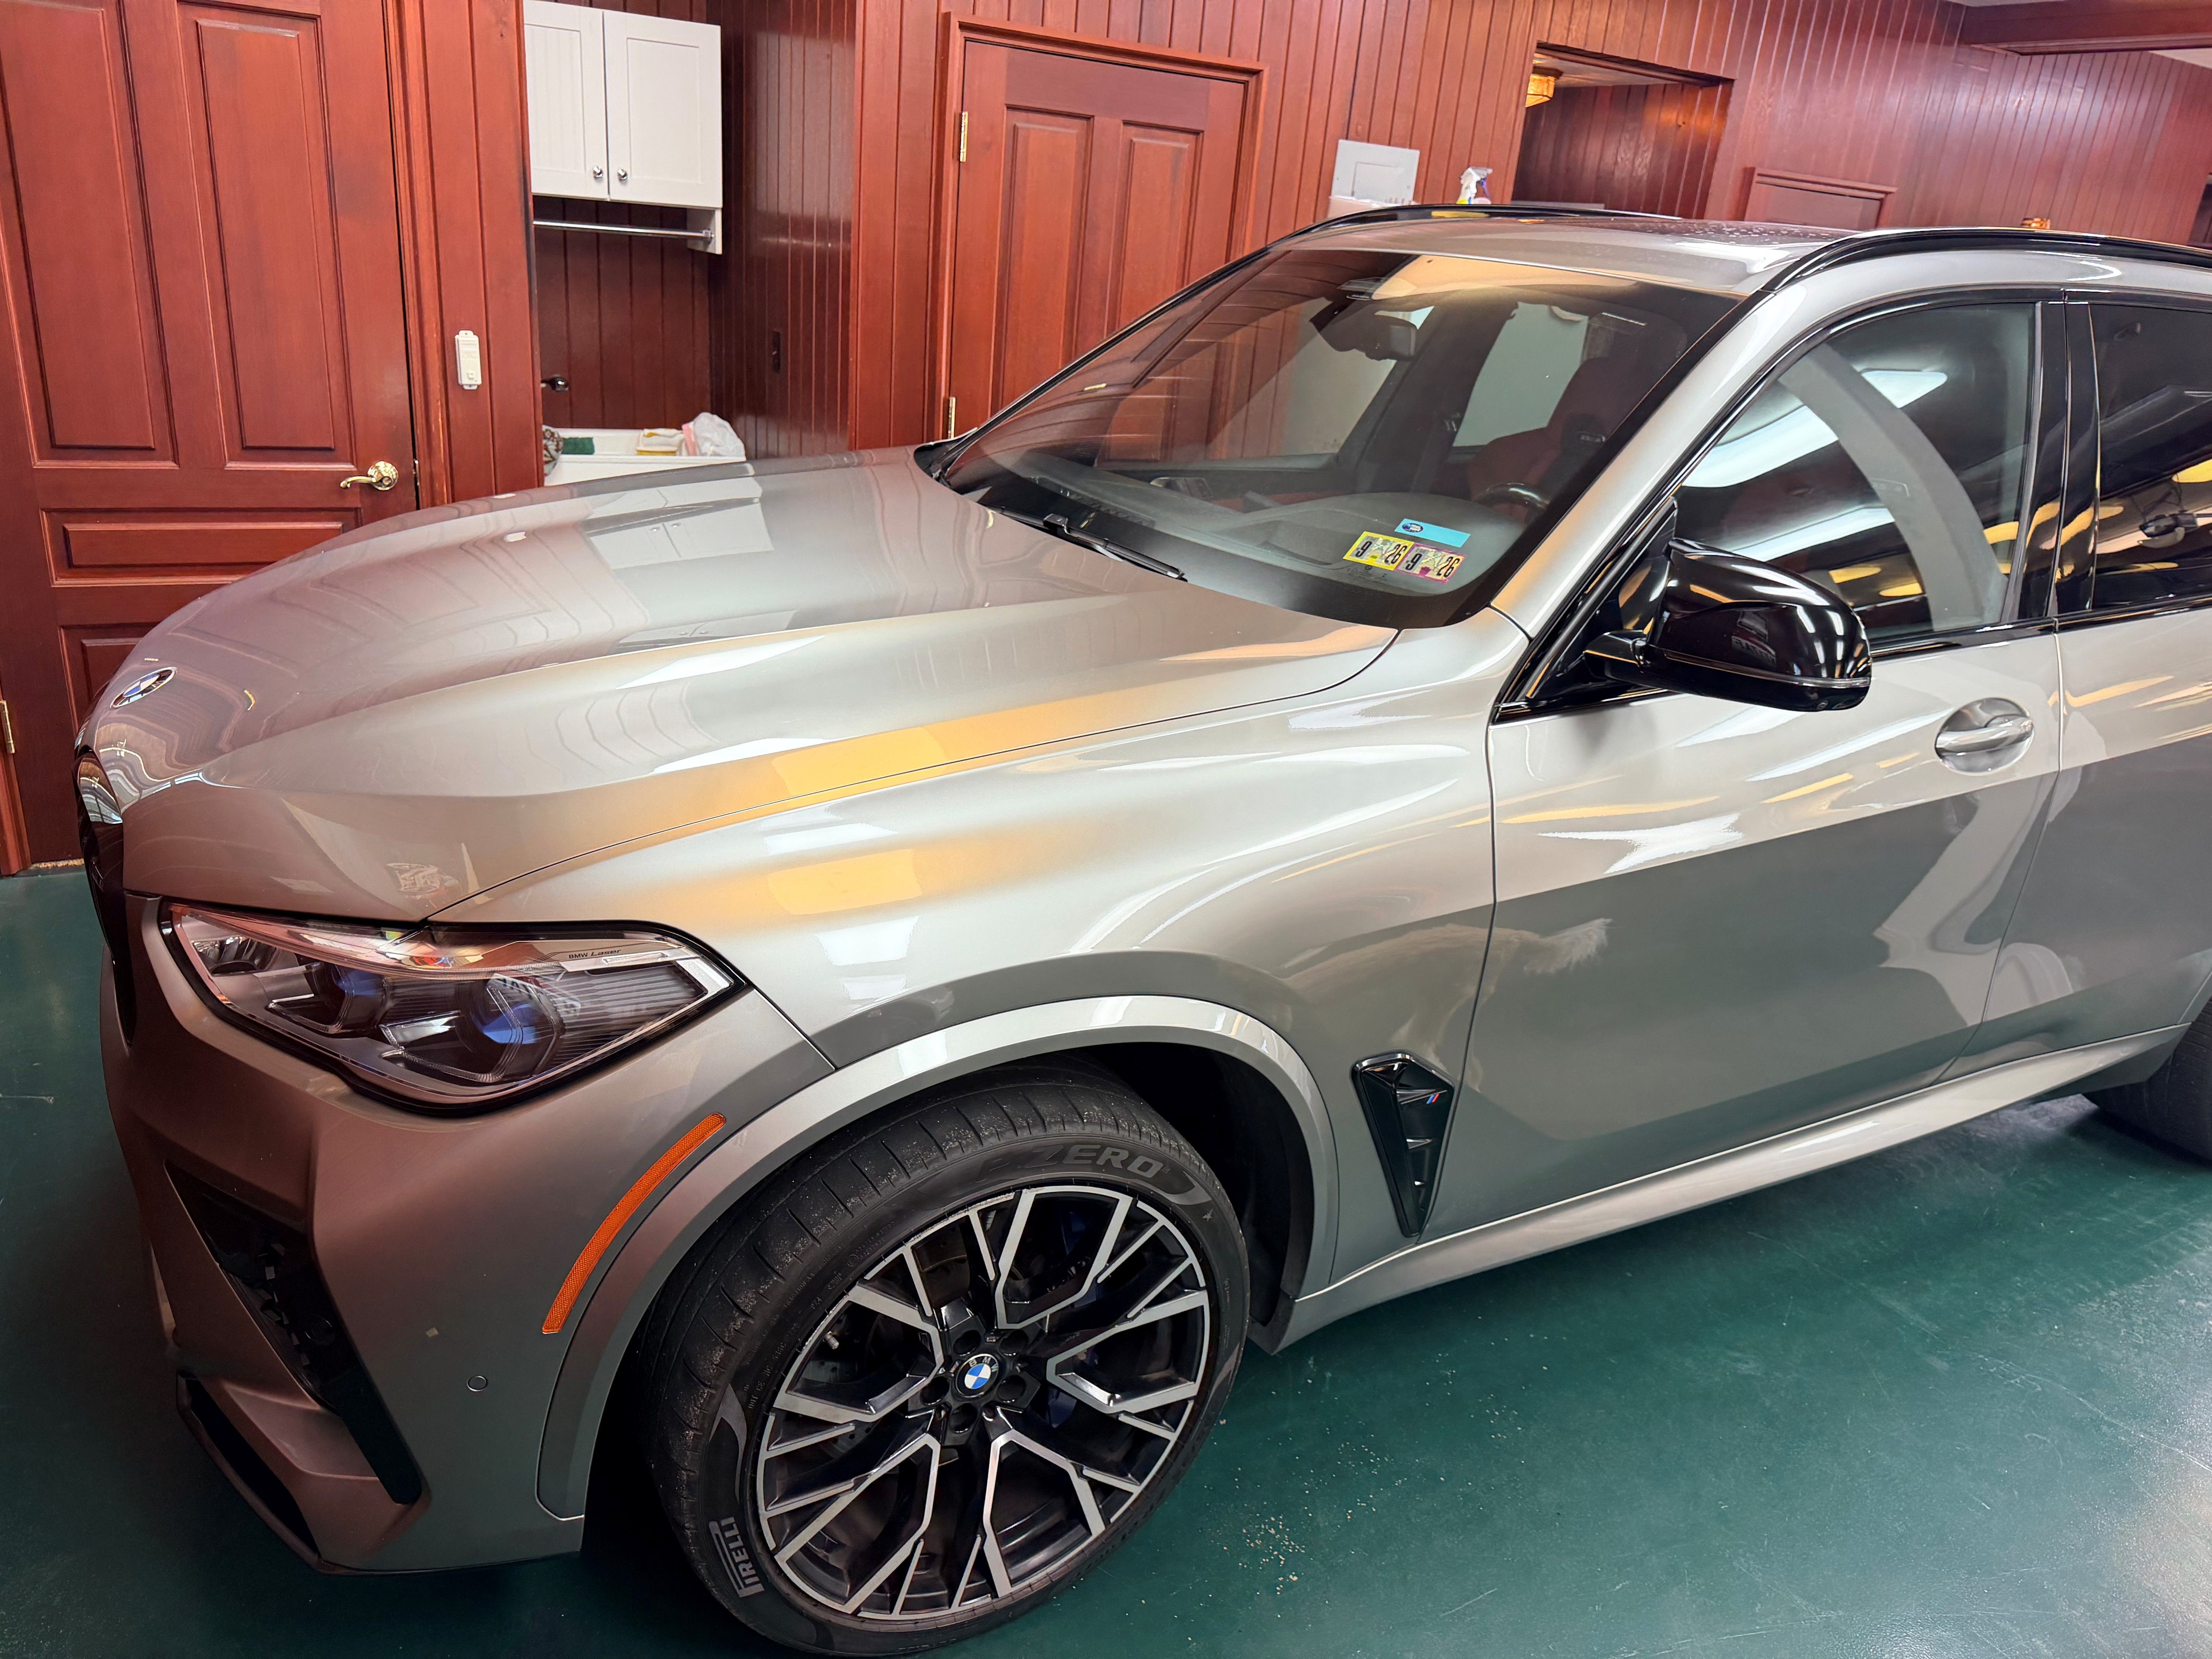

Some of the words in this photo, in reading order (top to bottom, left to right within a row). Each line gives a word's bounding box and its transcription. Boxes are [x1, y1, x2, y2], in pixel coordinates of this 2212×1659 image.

[1356, 541, 1372, 558] 9
[1384, 544, 1408, 564] 26
[1405, 553, 1422, 570] 9
[1437, 556, 1459, 578] 26
[1023, 1144, 1163, 1178] ZERO
[969, 1356, 998, 1372] BMW
[709, 1516, 765, 1598] PIRELLI
